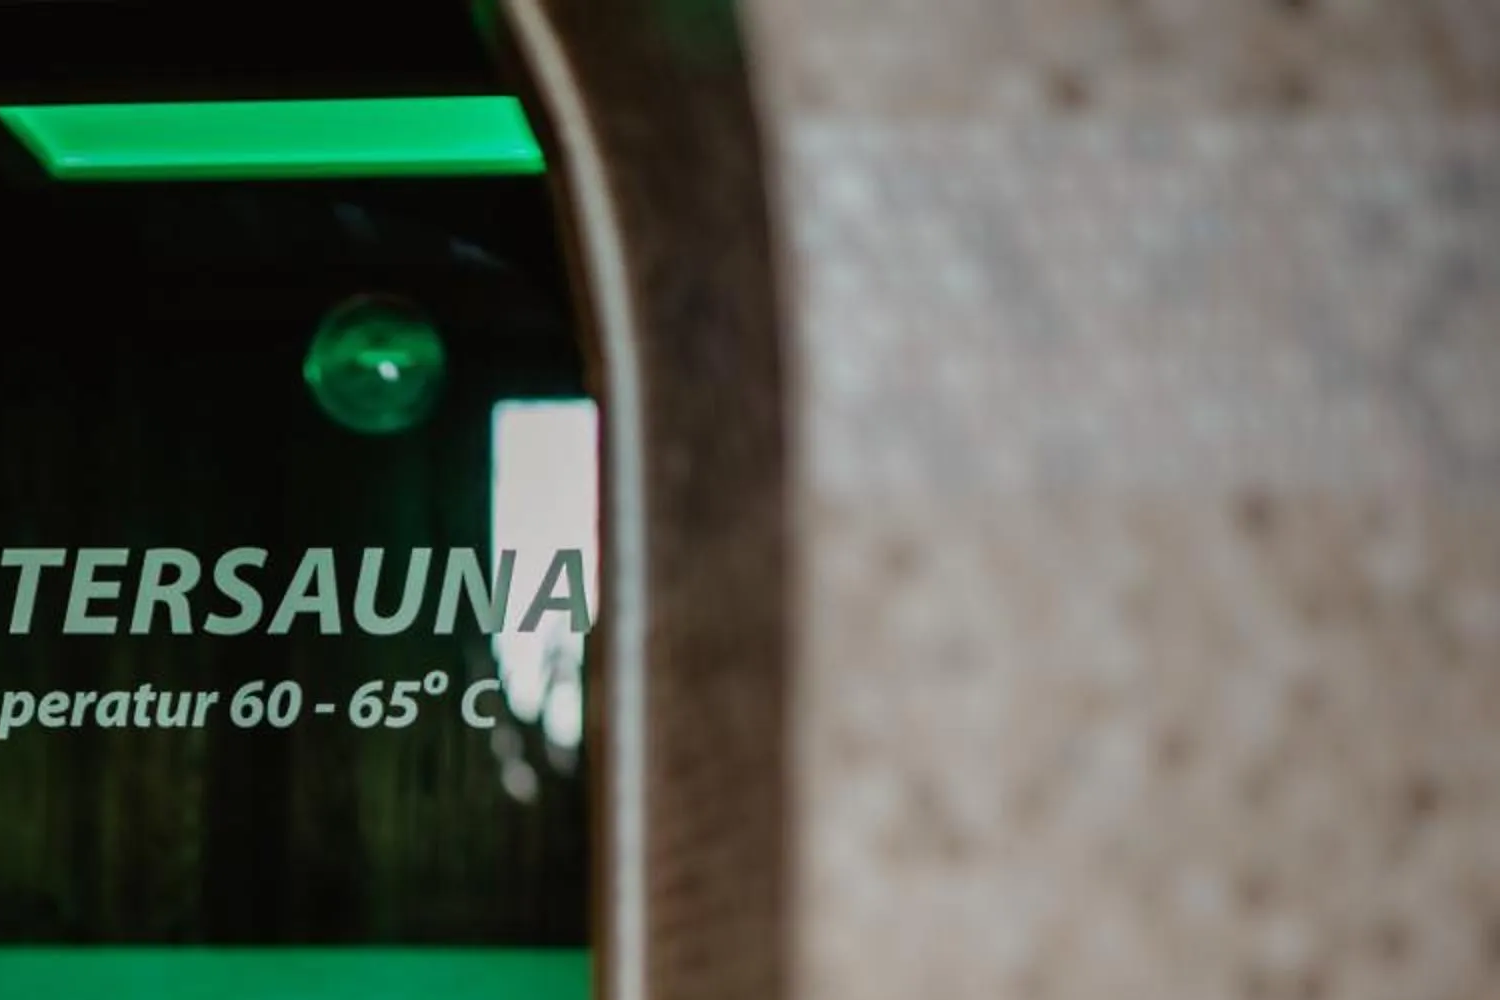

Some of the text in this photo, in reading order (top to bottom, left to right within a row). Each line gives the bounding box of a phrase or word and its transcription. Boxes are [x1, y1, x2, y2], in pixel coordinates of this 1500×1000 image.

[229, 679, 303, 728] 60
[315, 703, 335, 714] -
[461, 679, 501, 729] C
